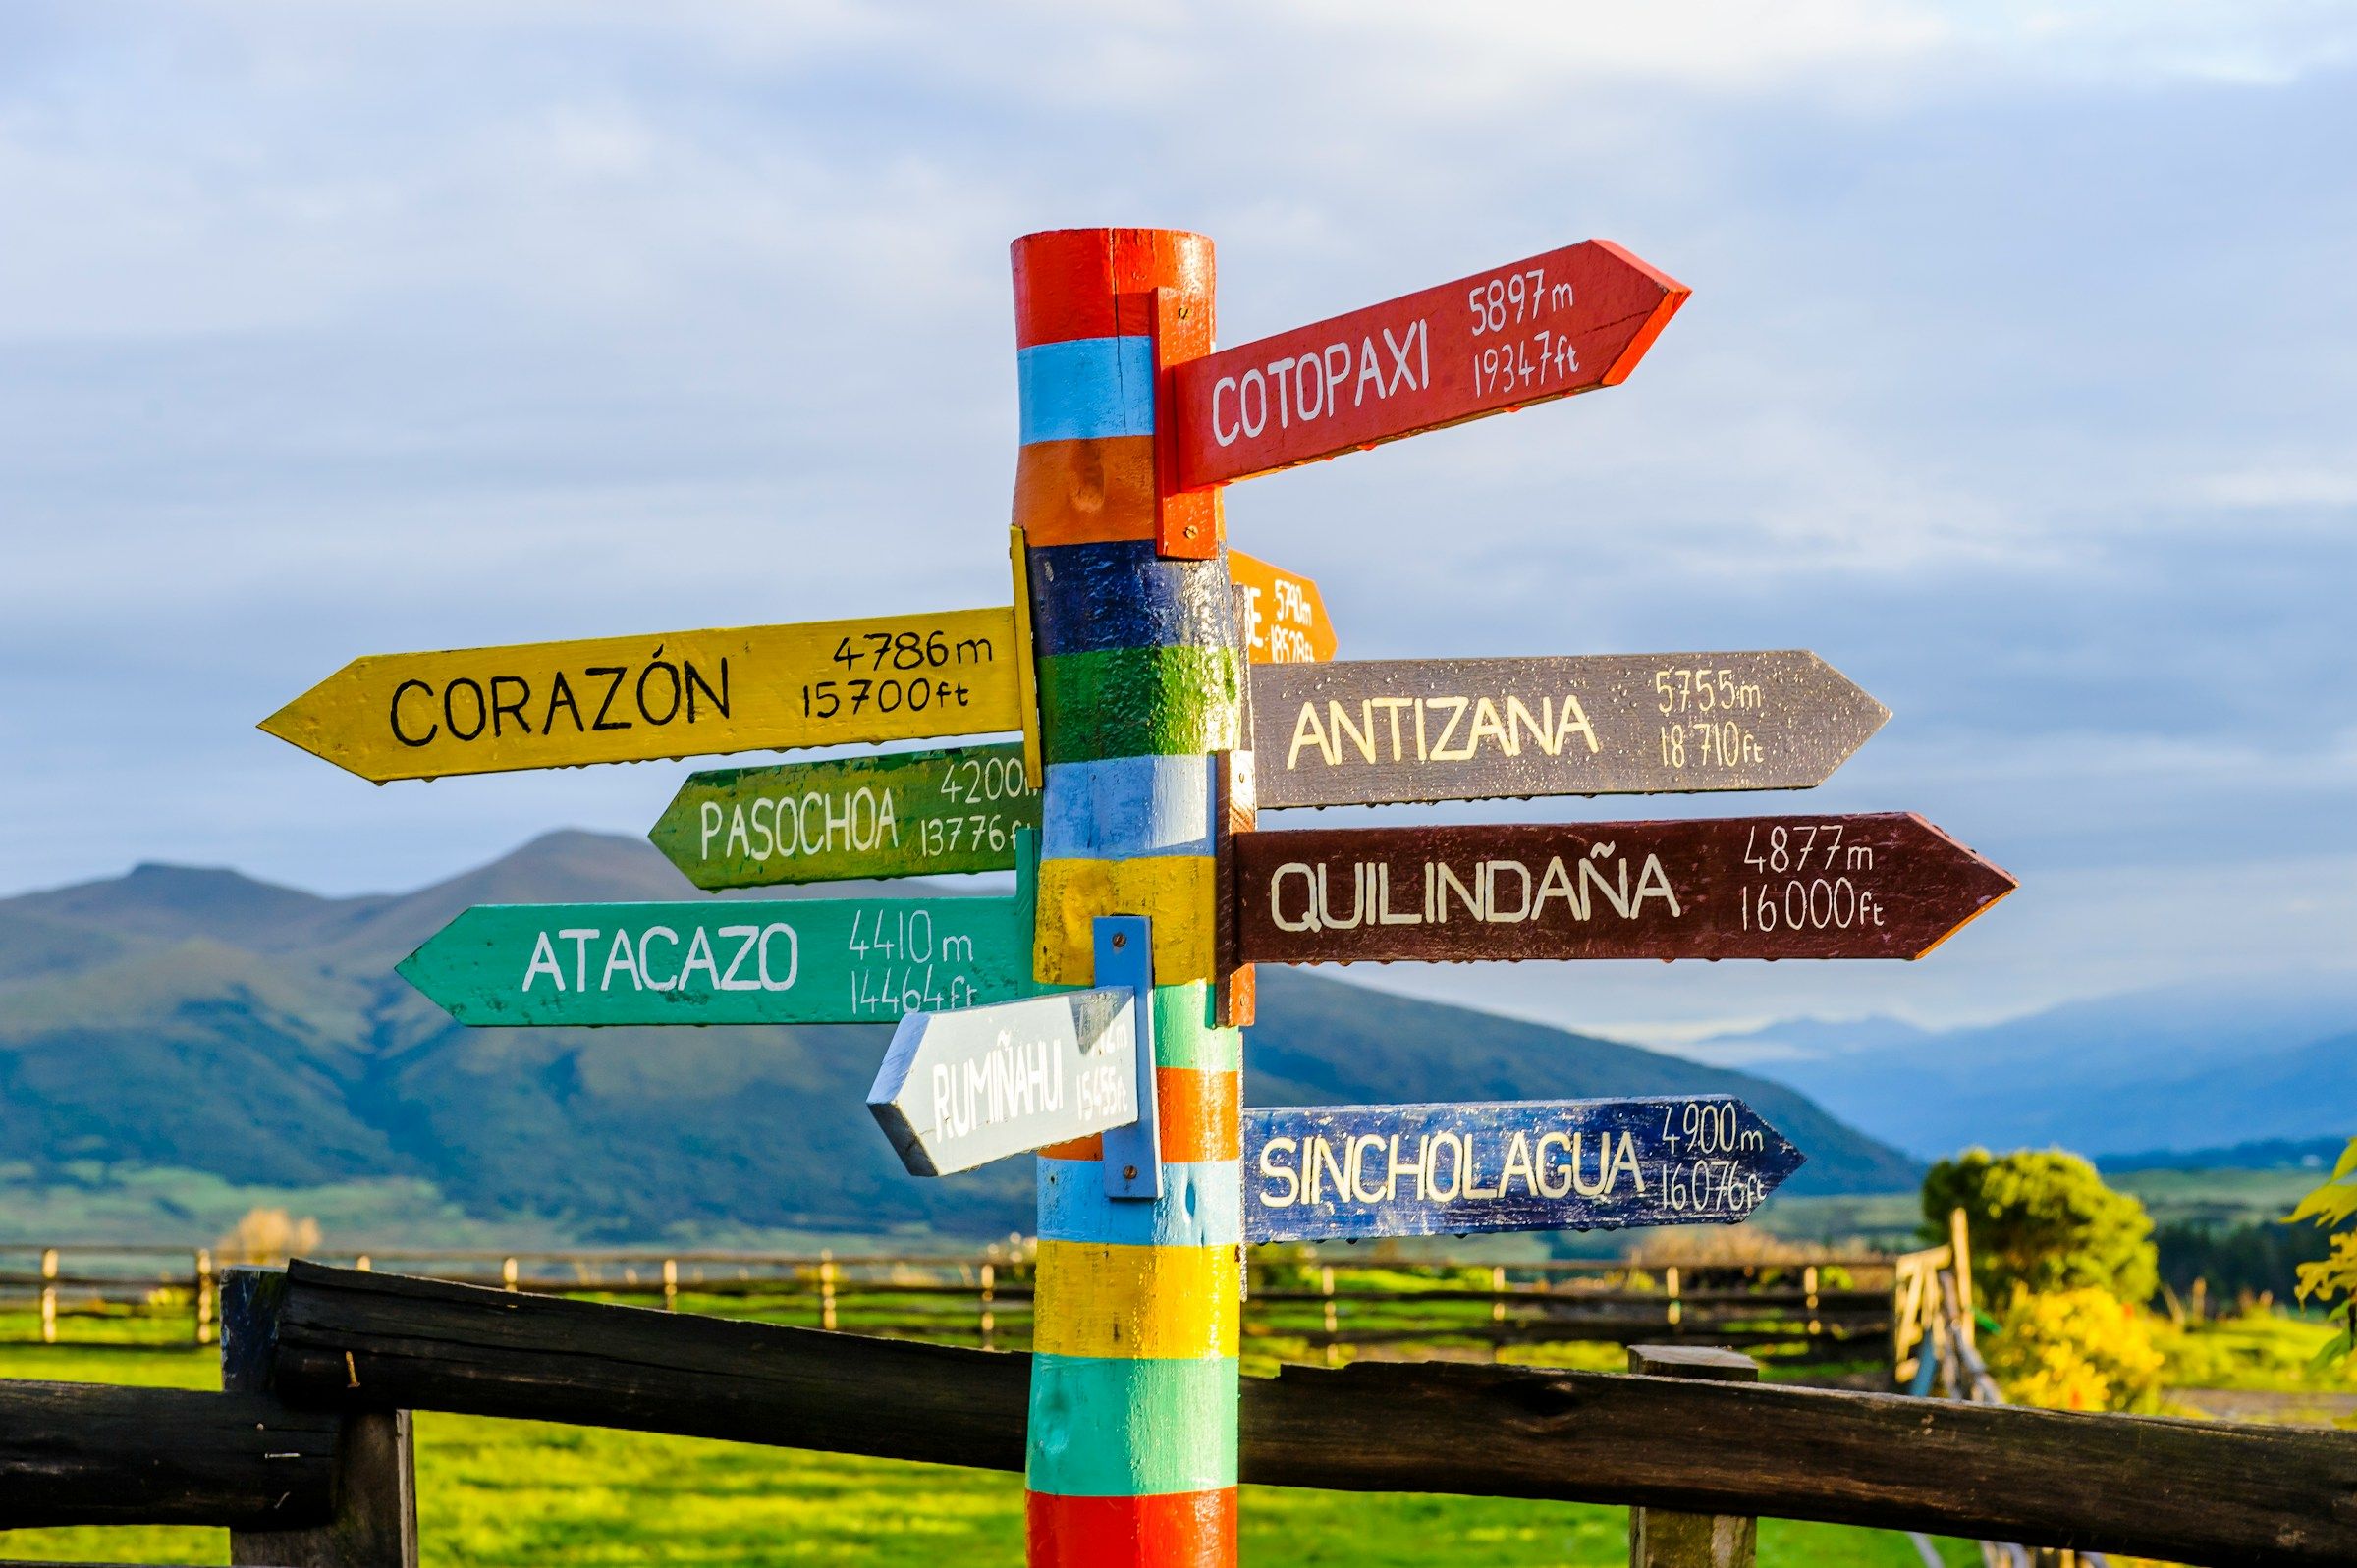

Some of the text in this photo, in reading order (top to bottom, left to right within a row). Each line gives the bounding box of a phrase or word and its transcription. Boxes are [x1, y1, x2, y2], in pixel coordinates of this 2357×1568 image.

[1212, 318, 1431, 448] COTOPAXI
[1474, 330, 1579, 398] 19347ft
[833, 630, 993, 672] 4786m
[390, 643, 731, 748] CORAZÓN
[803, 677, 969, 719] 15700ft
[1655, 669, 1761, 713] 5755m
[1287, 694, 1599, 770] ANTIZANA
[700, 786, 899, 862] PASOCHOA
[921, 814, 1031, 858] 13776f
[1270, 840, 1681, 933] QUILINDAÑA
[521, 922, 798, 993] ATACAZO
[933, 1028, 1064, 1144] RUMIÑAHUI
[1258, 1130, 1645, 1209] SINCHOLAGUA
